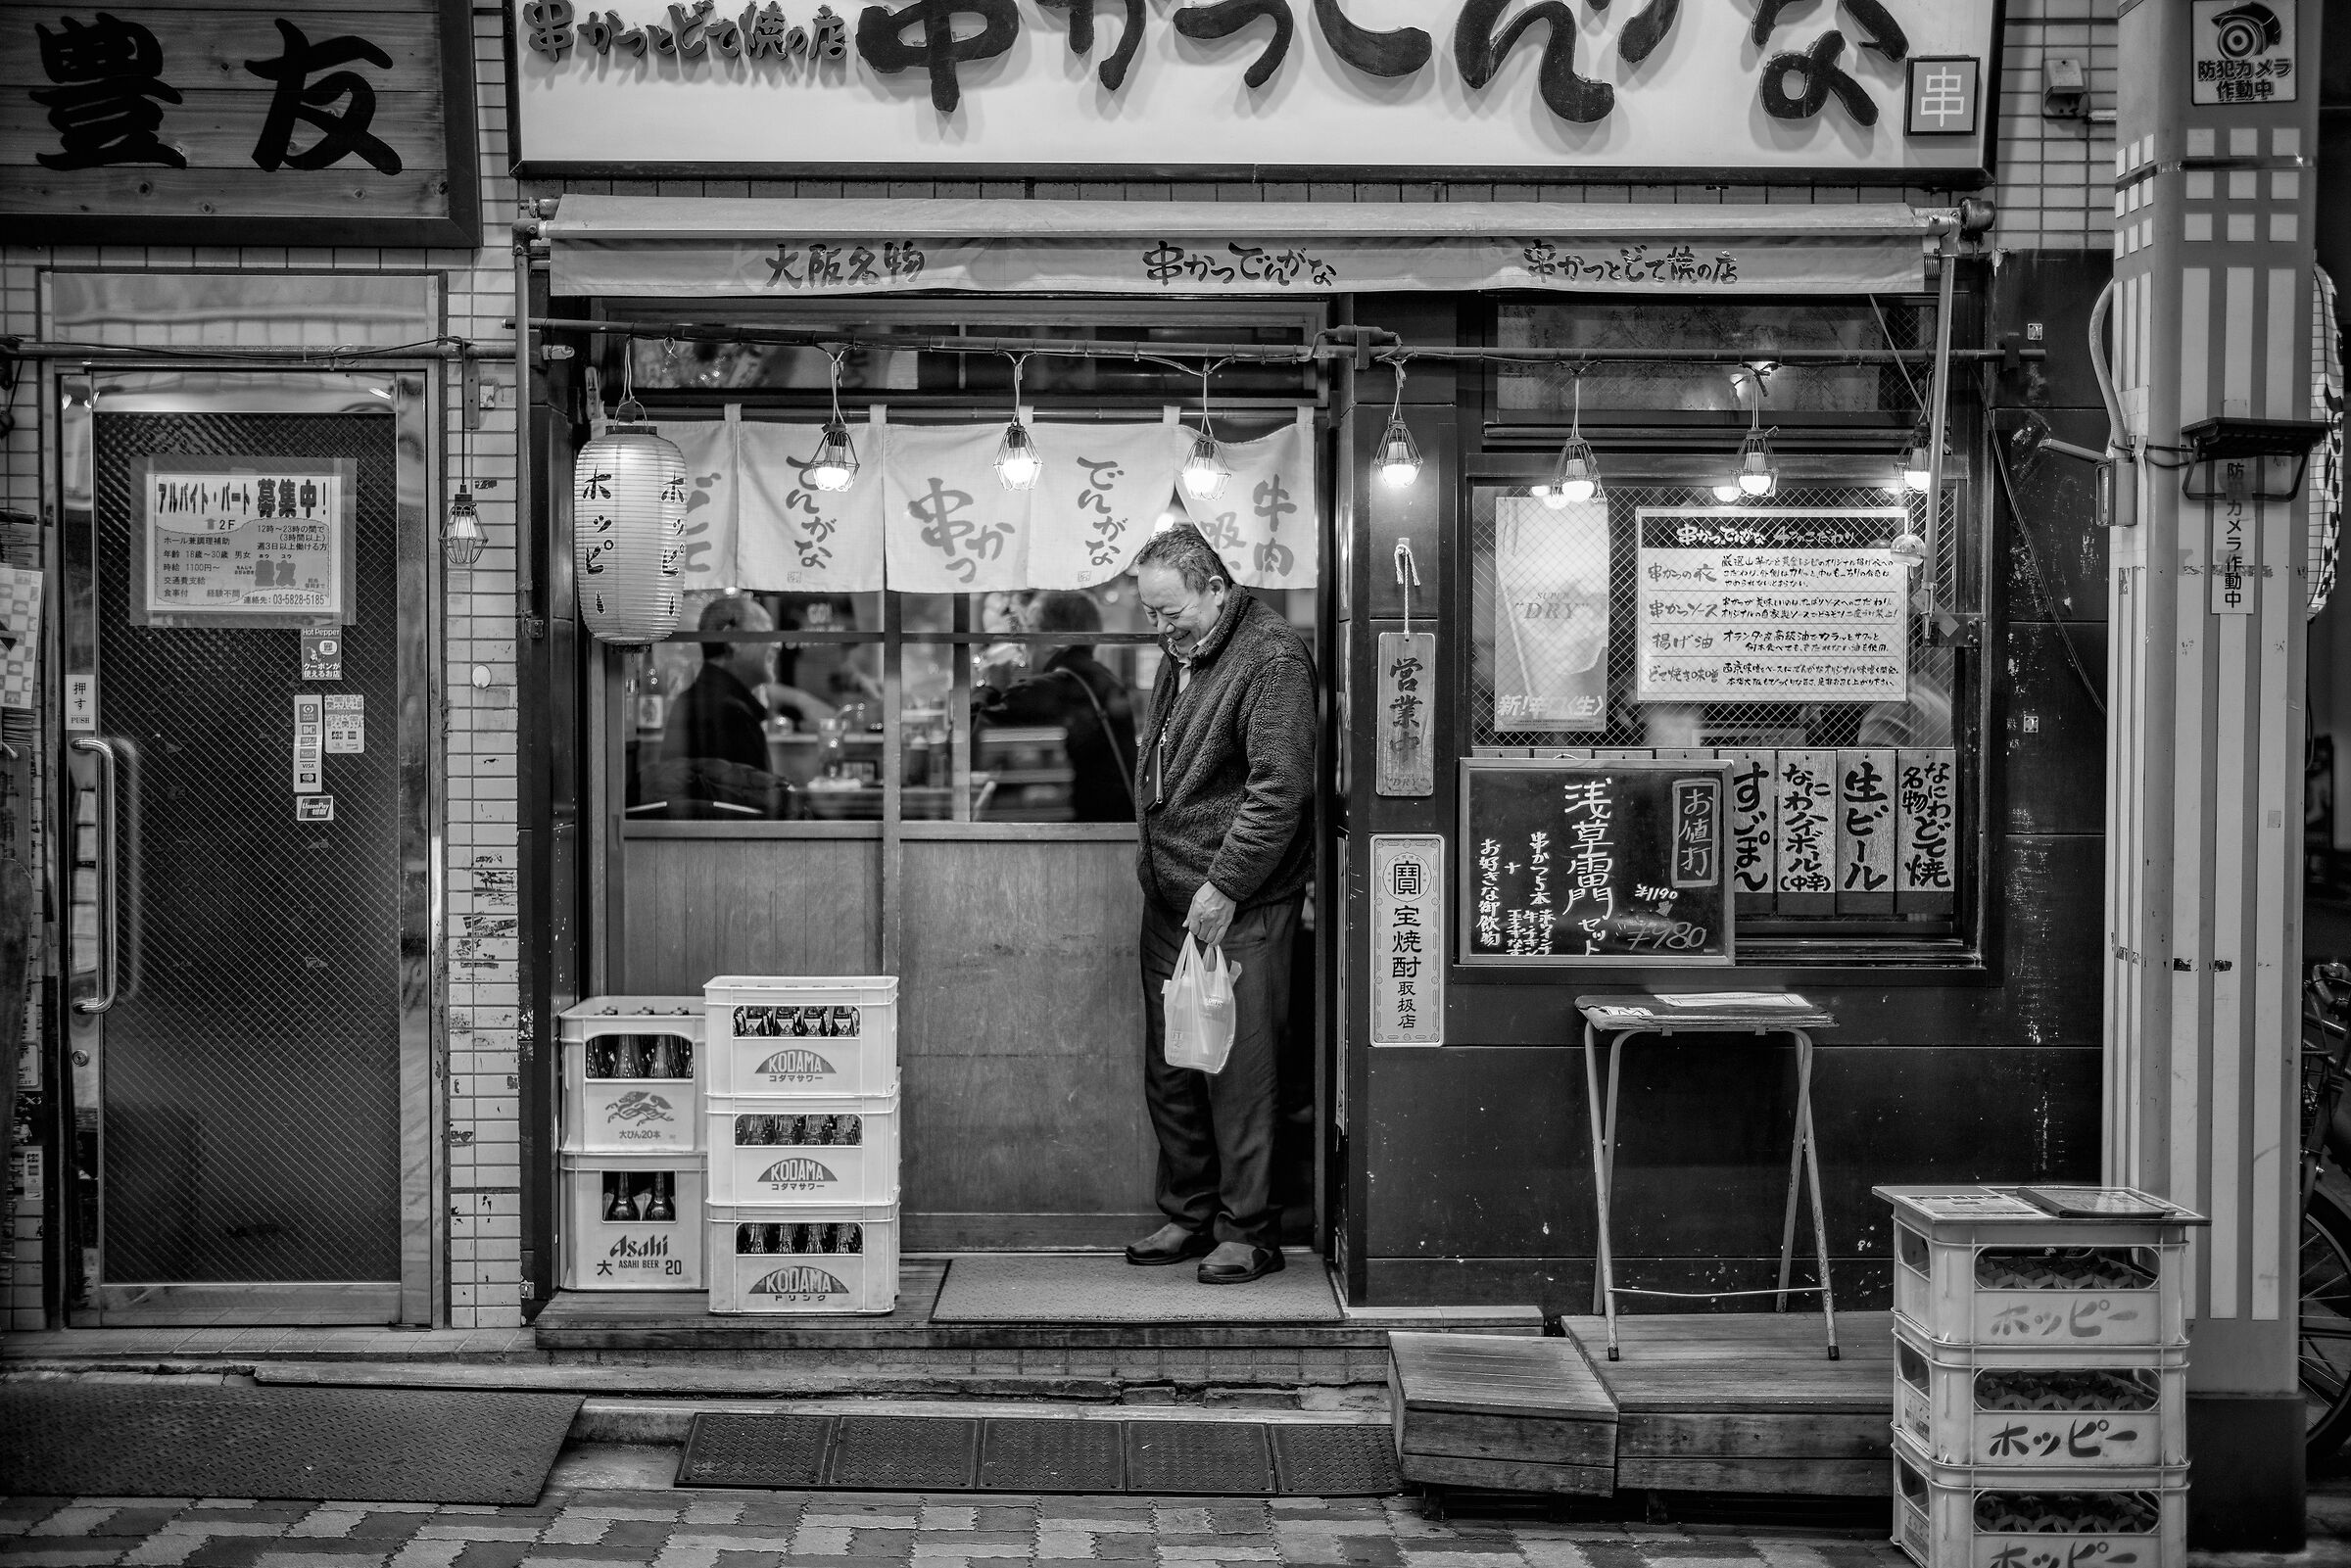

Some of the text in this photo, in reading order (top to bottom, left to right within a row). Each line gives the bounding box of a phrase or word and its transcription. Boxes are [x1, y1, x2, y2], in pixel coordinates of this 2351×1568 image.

[2197, 60, 2292, 81] 防犯カメラ
[28, 13, 403, 175] 豊友
[1920, 65, 1965, 127] 串
[2215, 80, 2275, 102] 作動中
[765, 240, 926, 290] 大阪名物
[1142, 240, 1337, 287] 串かつでんがな
[218, 519, 236, 530] 2F
[1077, 455, 1129, 566] でんがな
[1253, 473, 1298, 578] 牛肉
[582, 463, 615, 615] ホッピー
[908, 477, 1016, 584] 串かつ
[2224, 462, 2244, 608] 防カメラ作動中
[272, 594, 325, 605] 03-5828-5185
[1651, 631, 1714, 651] 揚げ油
[73, 682, 86, 710] 押す
[1389, 656, 1424, 763] 営業中
[1843, 761, 1890, 891] 生ビール
[1561, 777, 1614, 957] 浅草雷門 セット
[1392, 904, 1422, 1029] 宝焼酎 取扱店
[768, 1051, 823, 1074] KODAMA
[618, 1129, 661, 1140] 大びん20本
[770, 1161, 825, 1182] KODAMA
[771, 1182, 825, 1191] コダマサワー
[609, 1234, 669, 1258] Asahi
[597, 1259, 683, 1276] 大 ASAHI BEER 20
[765, 1269, 833, 1294] KODAMA
[1990, 1299, 2139, 1338] ホッピー
[1989, 1418, 2138, 1458] ホッピー
[1989, 1540, 2138, 1568] ホッピー
